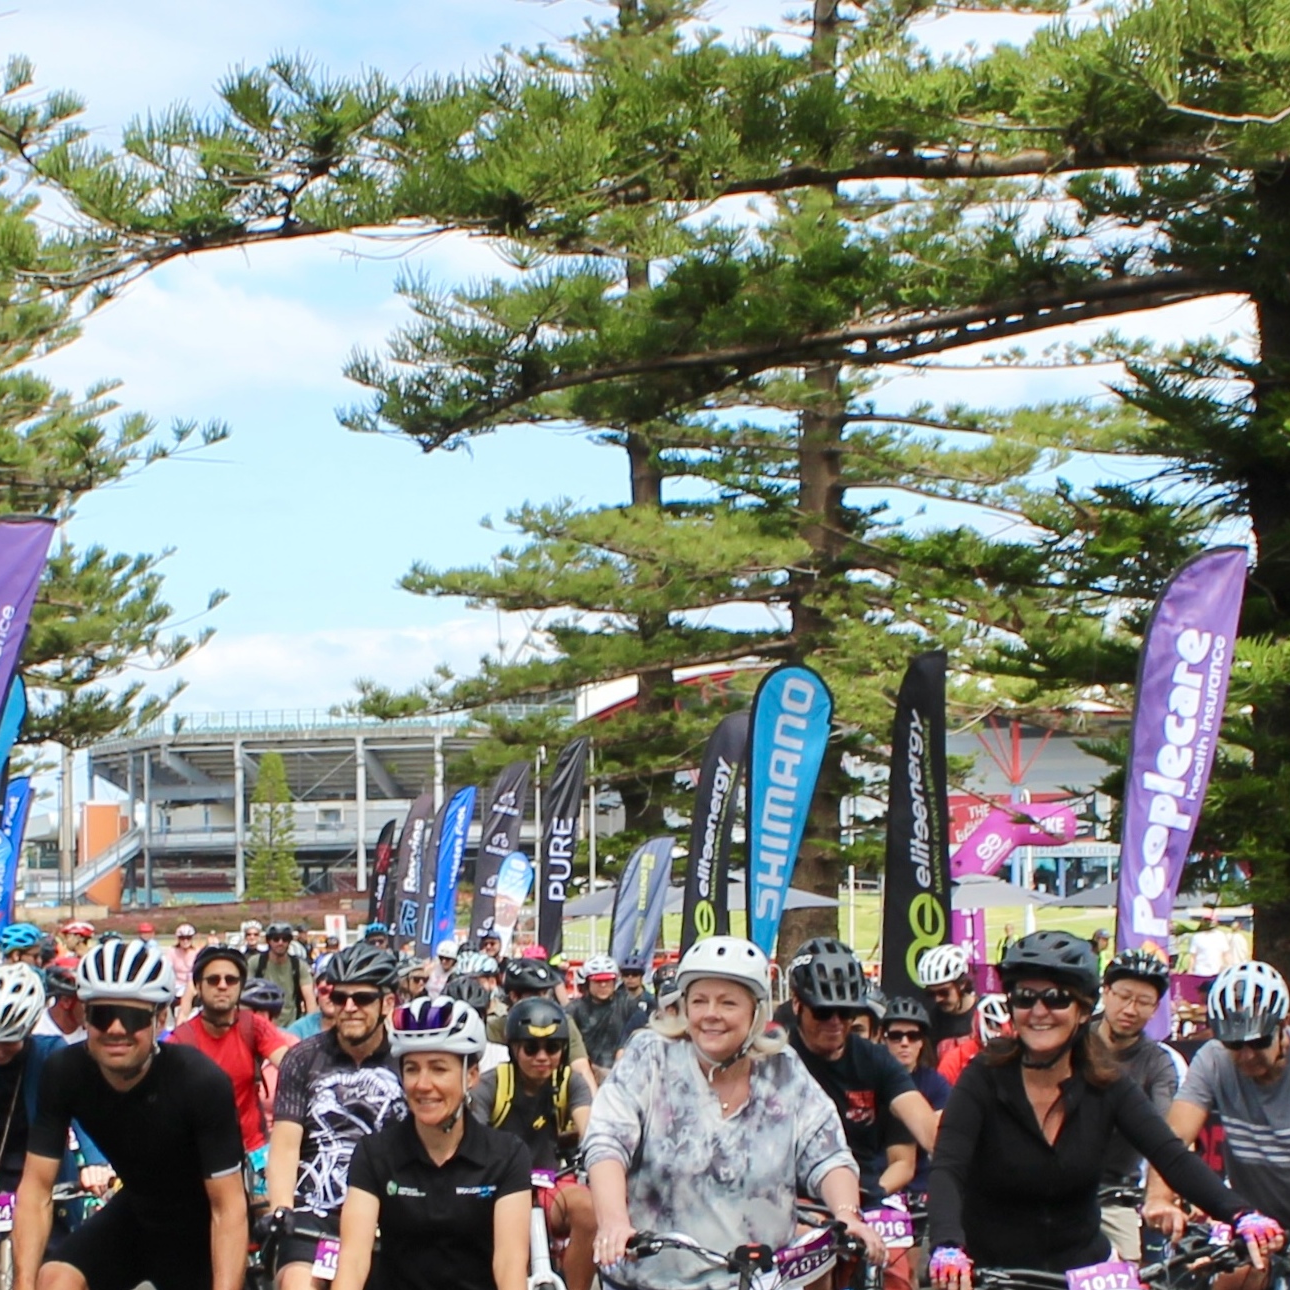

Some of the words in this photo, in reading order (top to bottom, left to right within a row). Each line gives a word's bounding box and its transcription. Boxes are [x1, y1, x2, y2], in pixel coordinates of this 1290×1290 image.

[1185, 734, 1210, 801] health
[1198, 633, 1227, 733] insurance
[755, 676, 816, 922] SHIMANO
[1029, 817, 1066, 834] BKE
[1132, 627, 1212, 938] Peoplecare
[548, 816, 574, 902] PURE
[1019, 845, 1088, 856] EERTAINMENT
